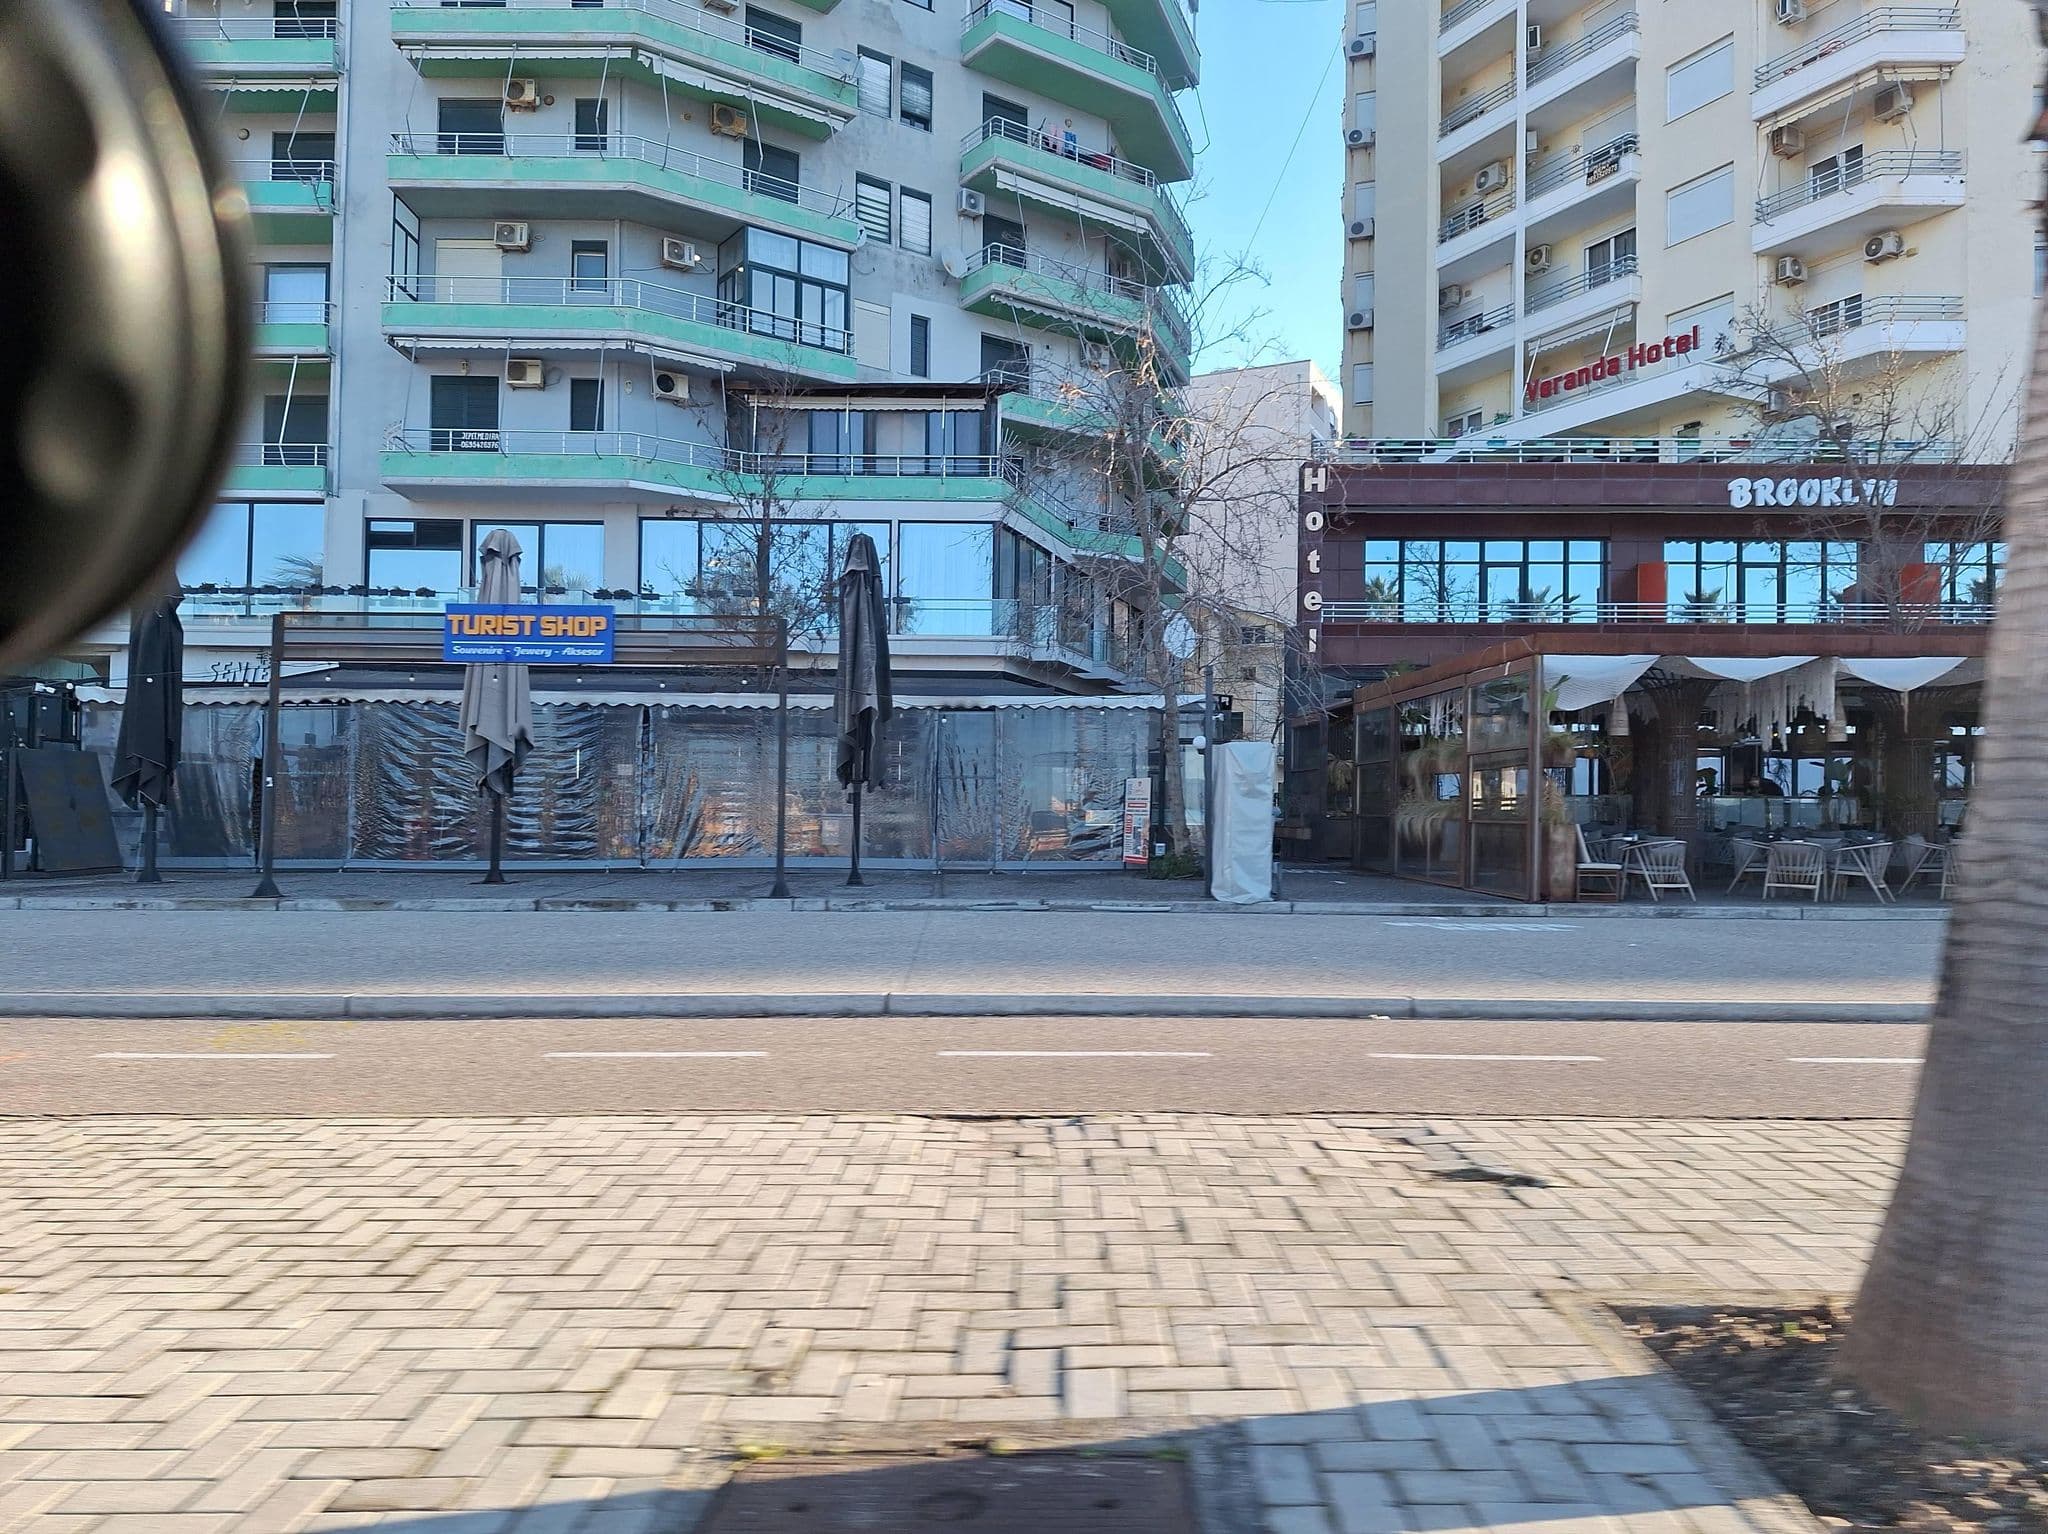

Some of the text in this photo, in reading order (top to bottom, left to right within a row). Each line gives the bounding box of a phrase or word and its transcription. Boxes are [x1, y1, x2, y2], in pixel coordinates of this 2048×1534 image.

[1525, 324, 1700, 403] Veranda Hotel
[1303, 467, 1327, 653] Hotel
[447, 615, 607, 637] TURIST SHOP
